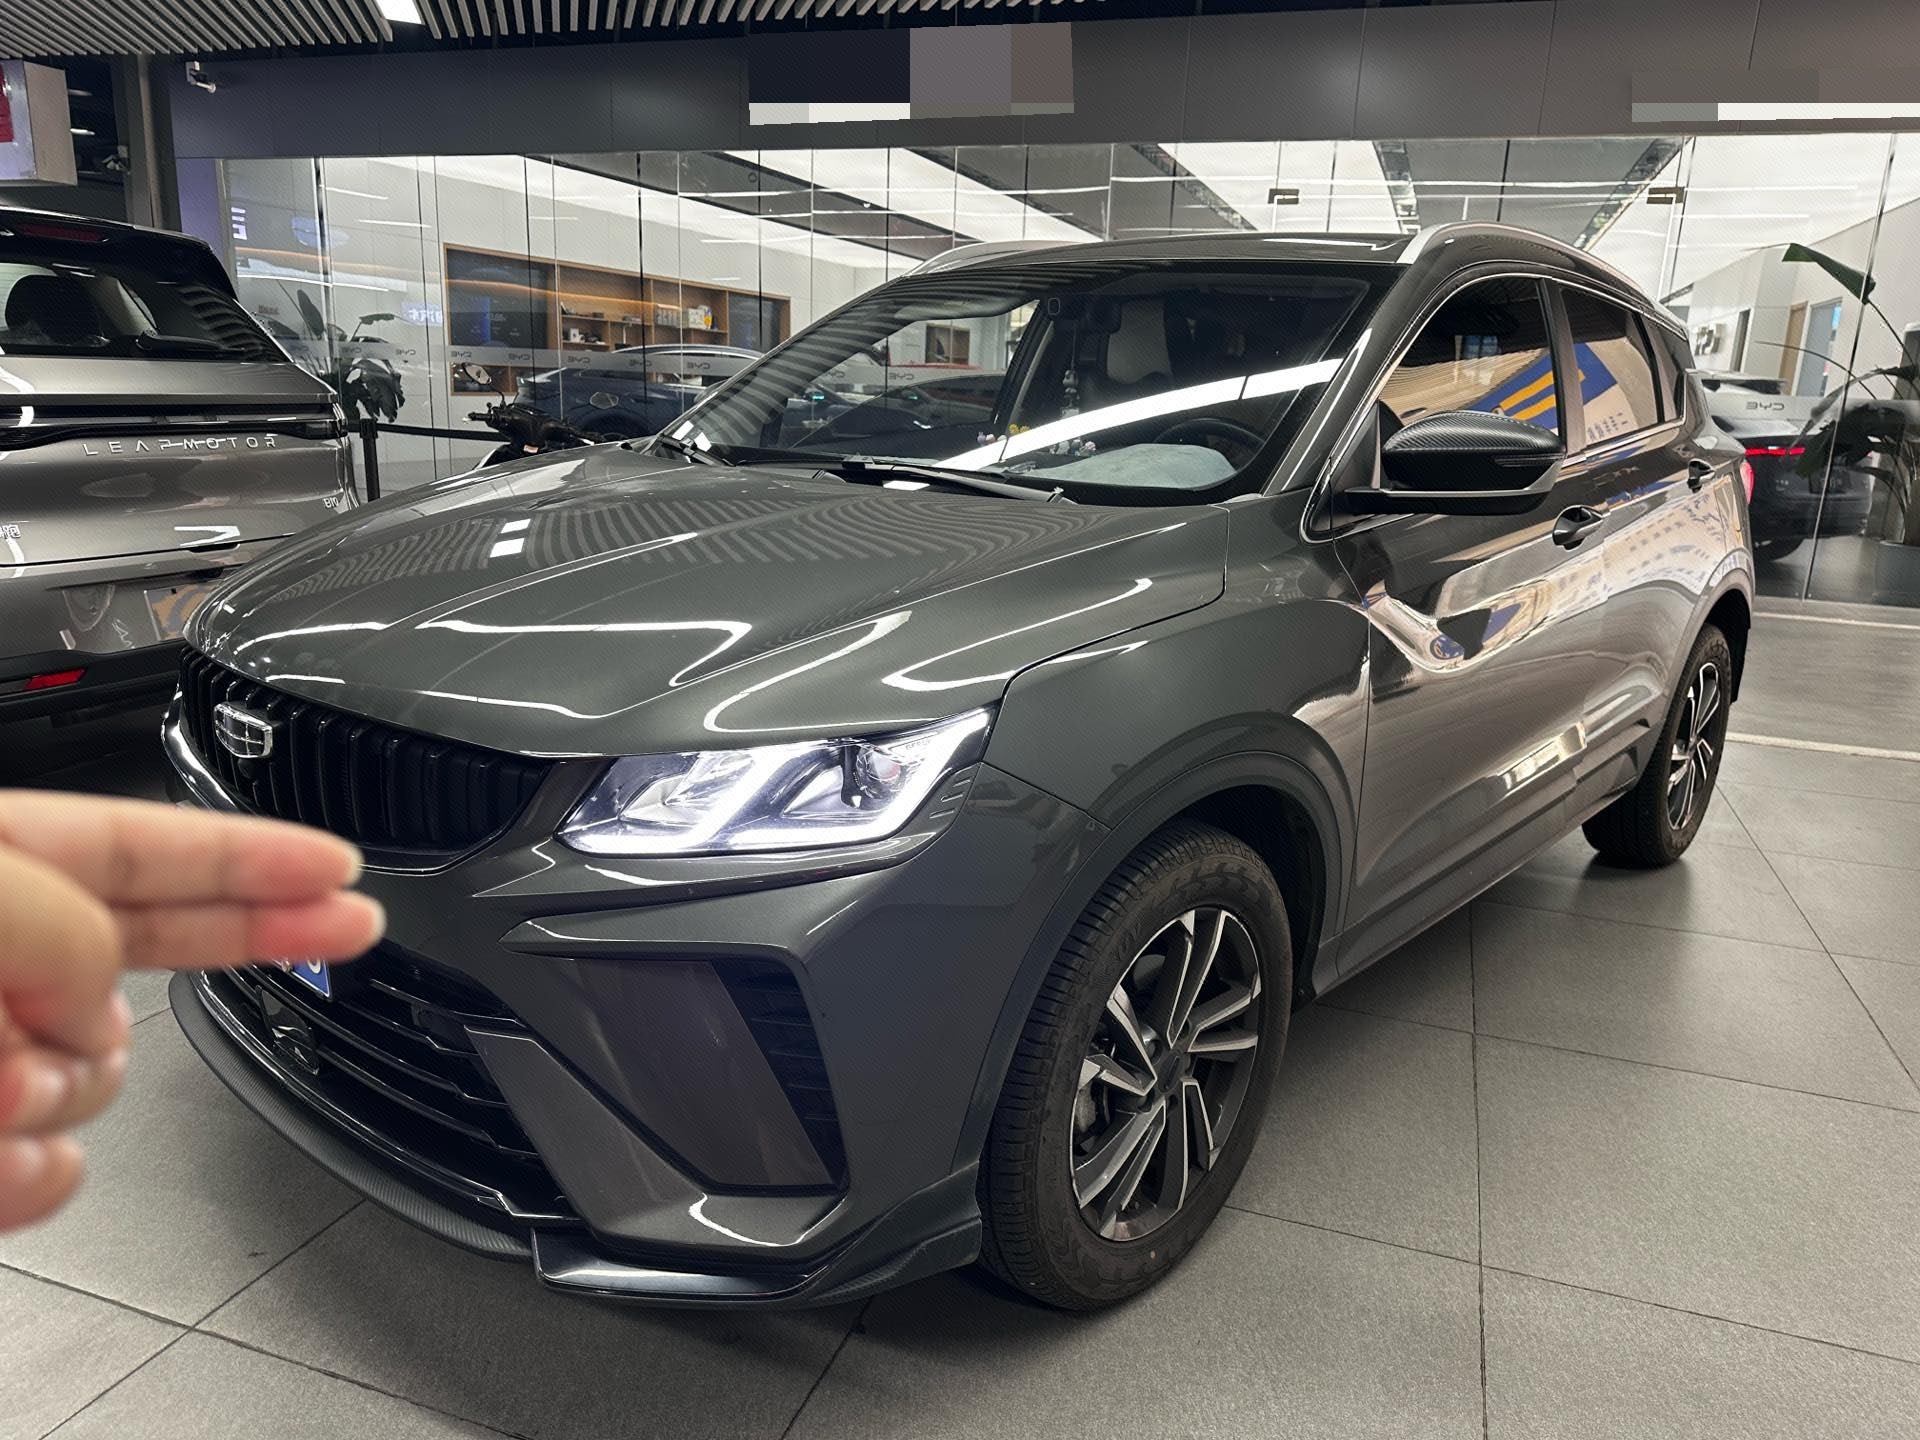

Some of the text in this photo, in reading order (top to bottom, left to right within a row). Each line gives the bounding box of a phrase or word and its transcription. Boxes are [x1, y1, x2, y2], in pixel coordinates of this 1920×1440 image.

[450, 350, 473, 358] BYD
[686, 361, 711, 370] BYD
[888, 372, 915, 381] BYD
[1746, 401, 1785, 411] BYD
[83, 433, 279, 456] LEAPMOTOR
